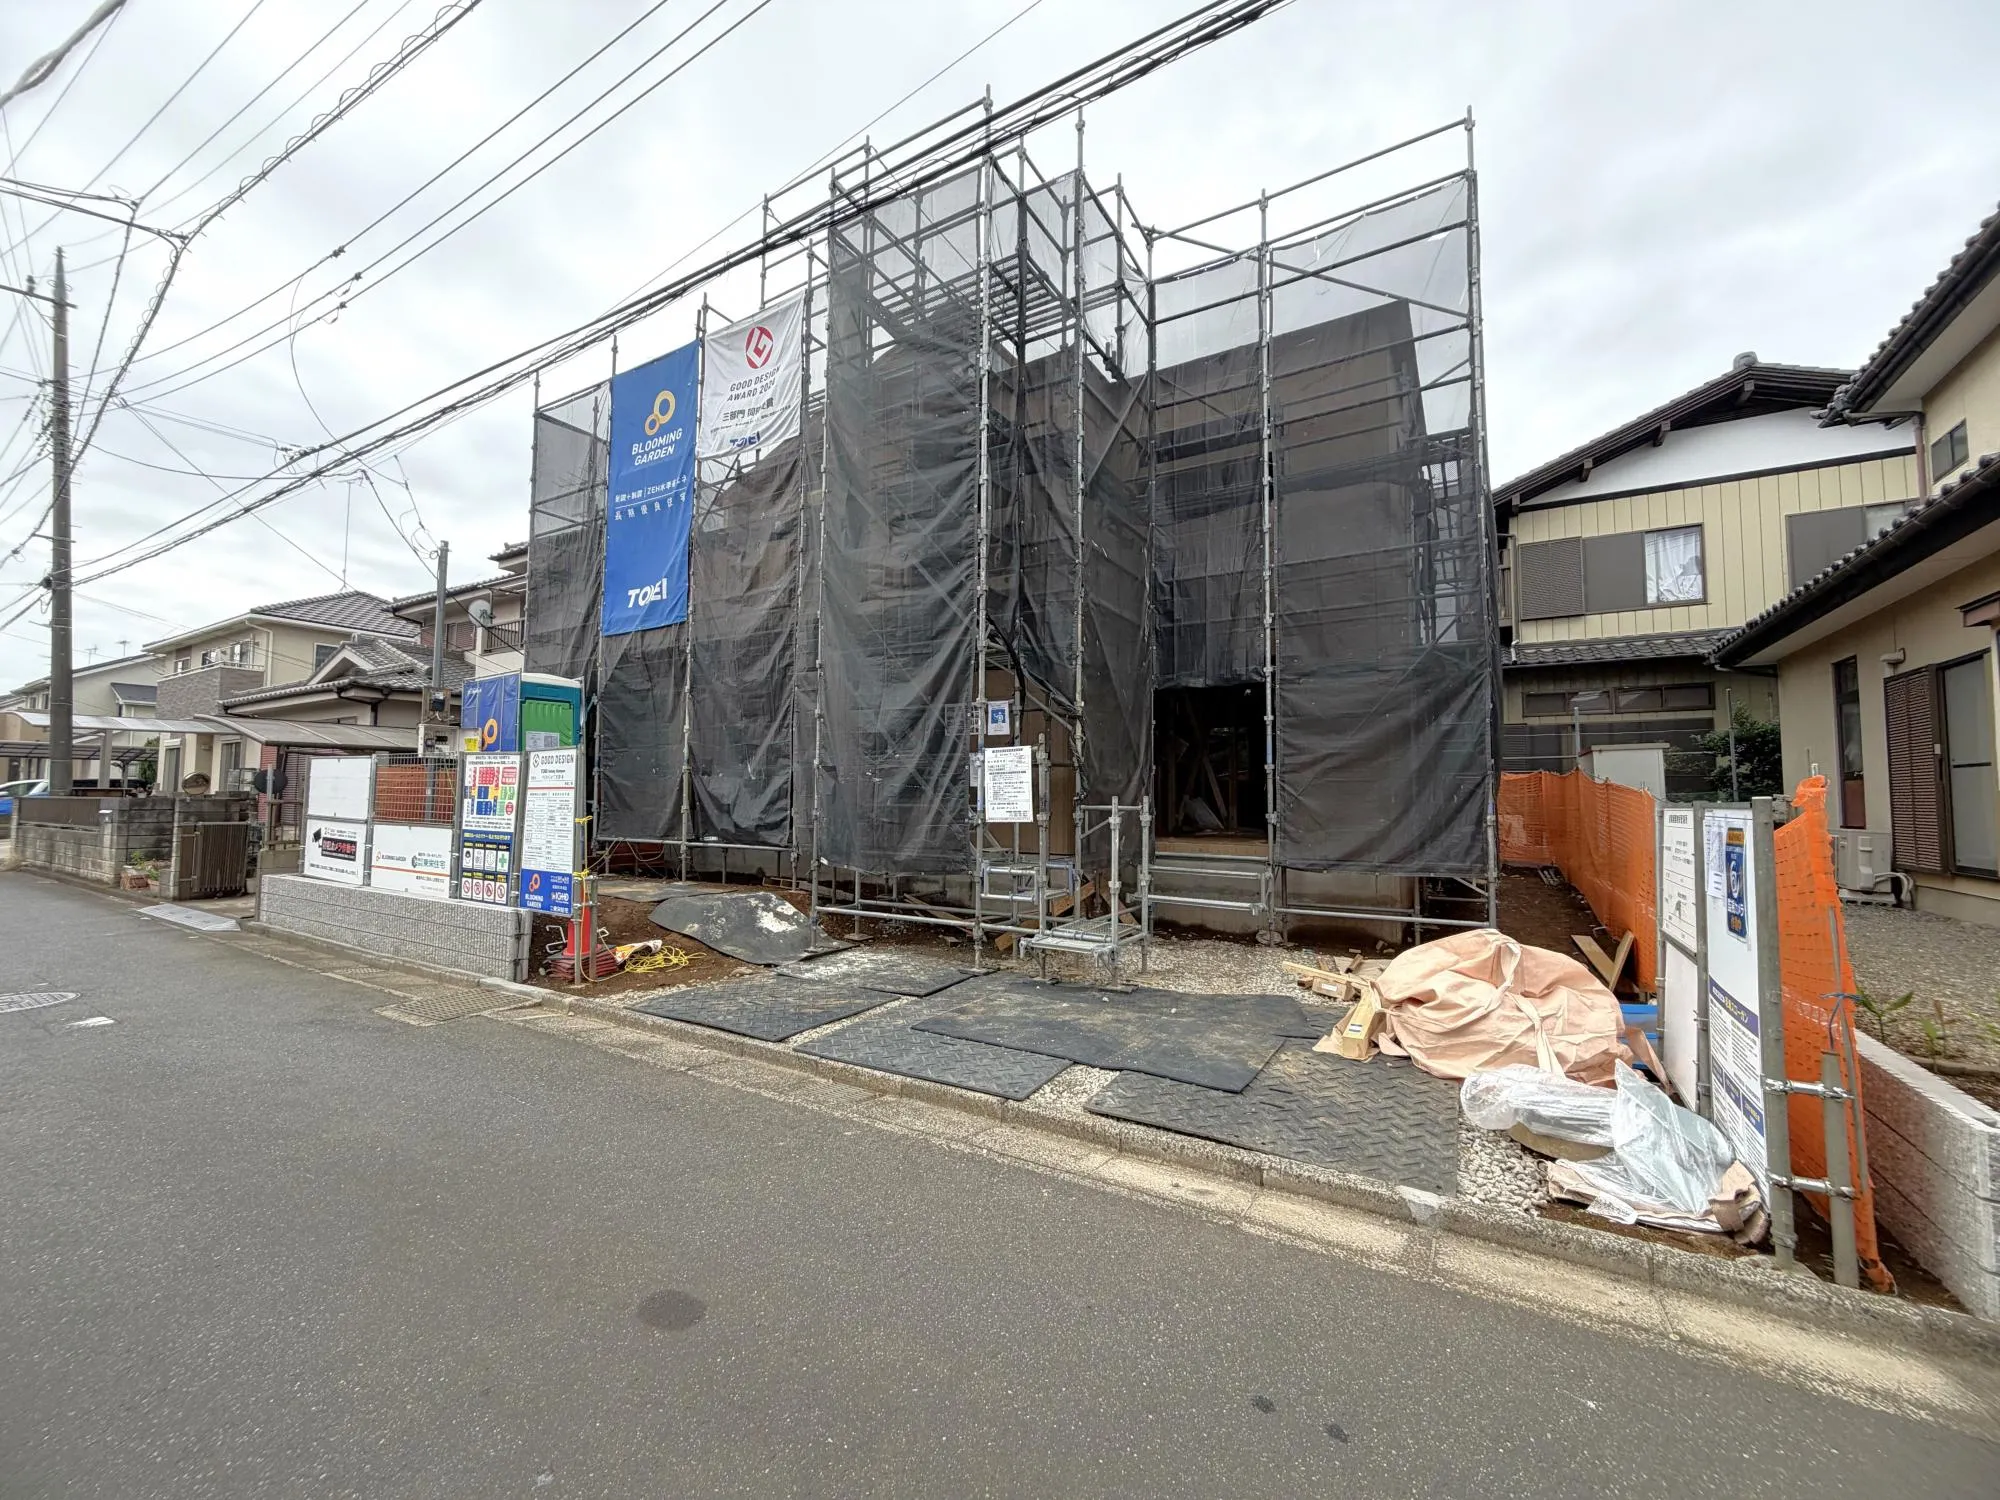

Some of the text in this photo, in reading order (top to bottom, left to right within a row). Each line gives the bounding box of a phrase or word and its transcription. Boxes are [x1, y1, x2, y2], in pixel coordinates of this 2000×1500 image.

[730, 364, 781, 392] GOOD DESIGN
[727, 387, 758, 402] AWARD
[722, 409, 746, 422] 三部門
[632, 427, 683, 456] BLOOMING
[730, 430, 761, 448] TOEI
[634, 445, 675, 467] GARDEN
[627, 577, 669, 608] TOEI
[541, 753, 574, 765] GOOD DESIGN
